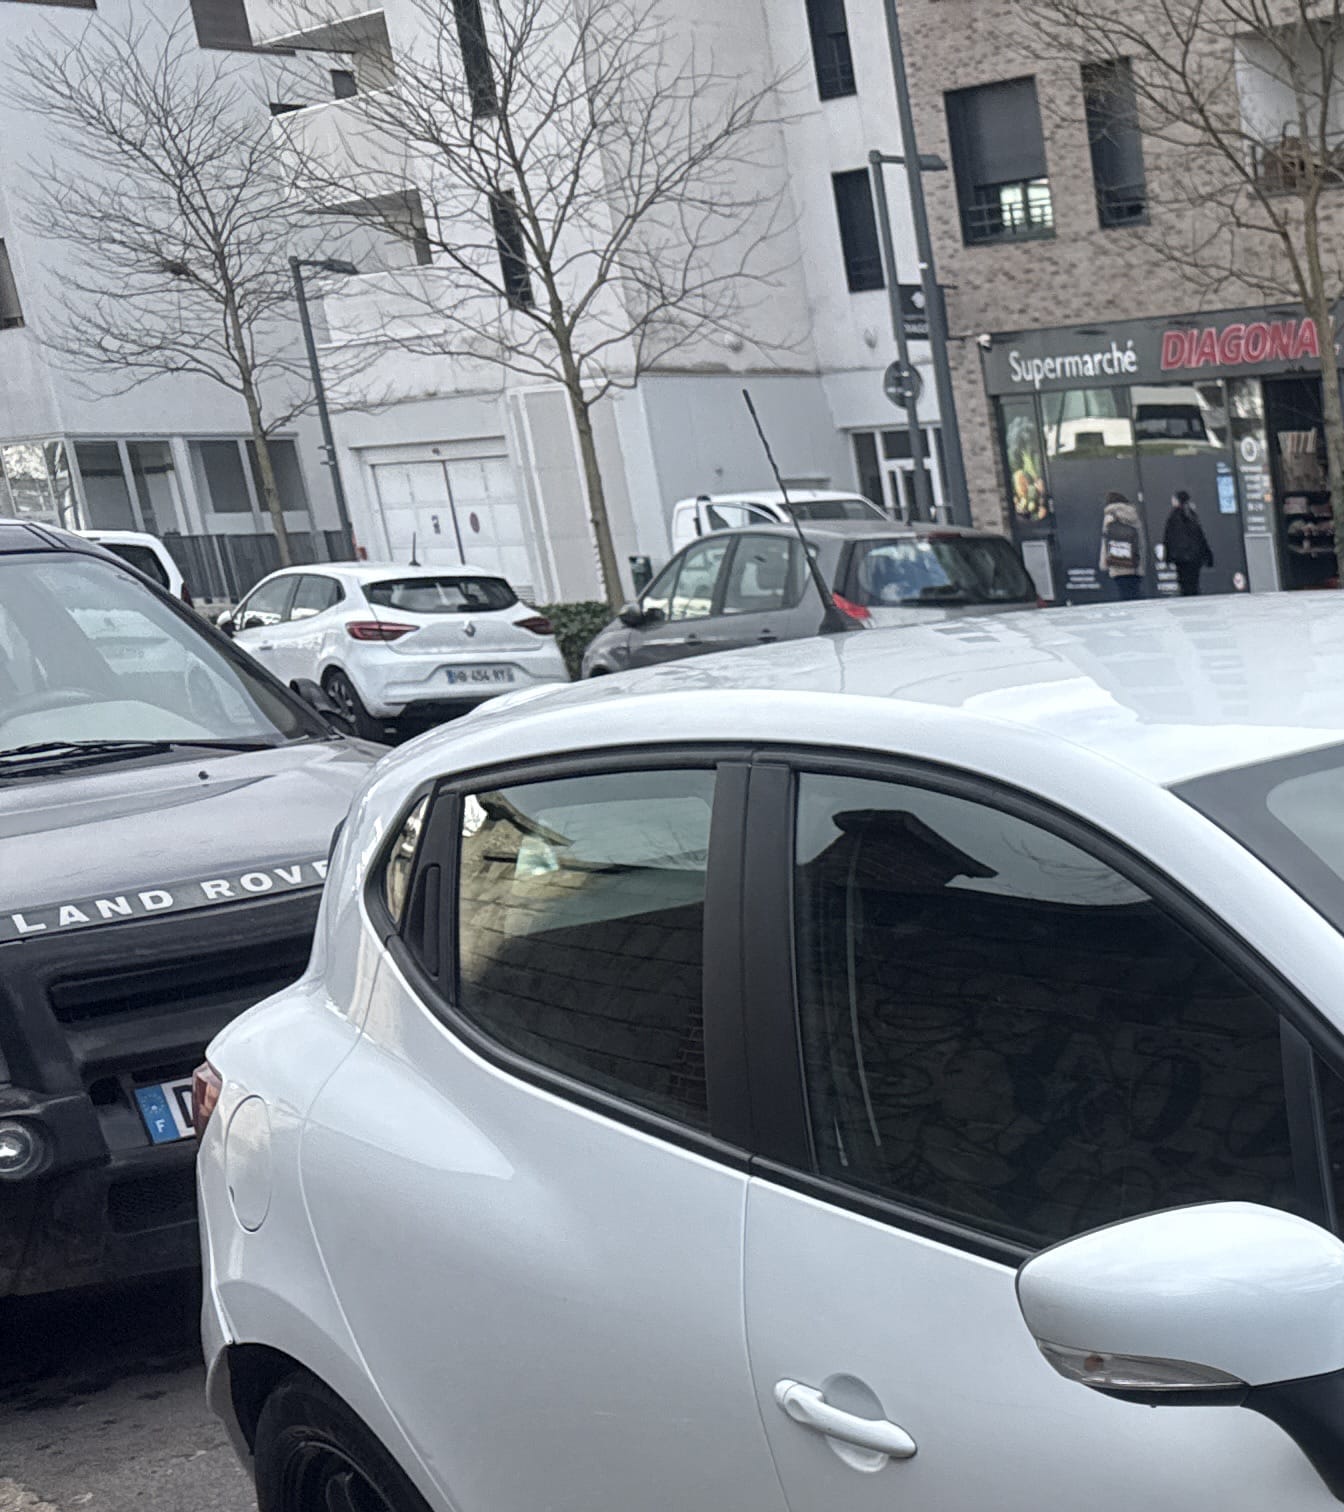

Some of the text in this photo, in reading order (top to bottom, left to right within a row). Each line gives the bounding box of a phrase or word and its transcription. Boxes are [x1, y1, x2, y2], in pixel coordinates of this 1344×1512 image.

[1009, 339, 1139, 390] Supermarché
[1160, 315, 1342, 370] DIAGONA
[12, 889, 174, 934] LAND
